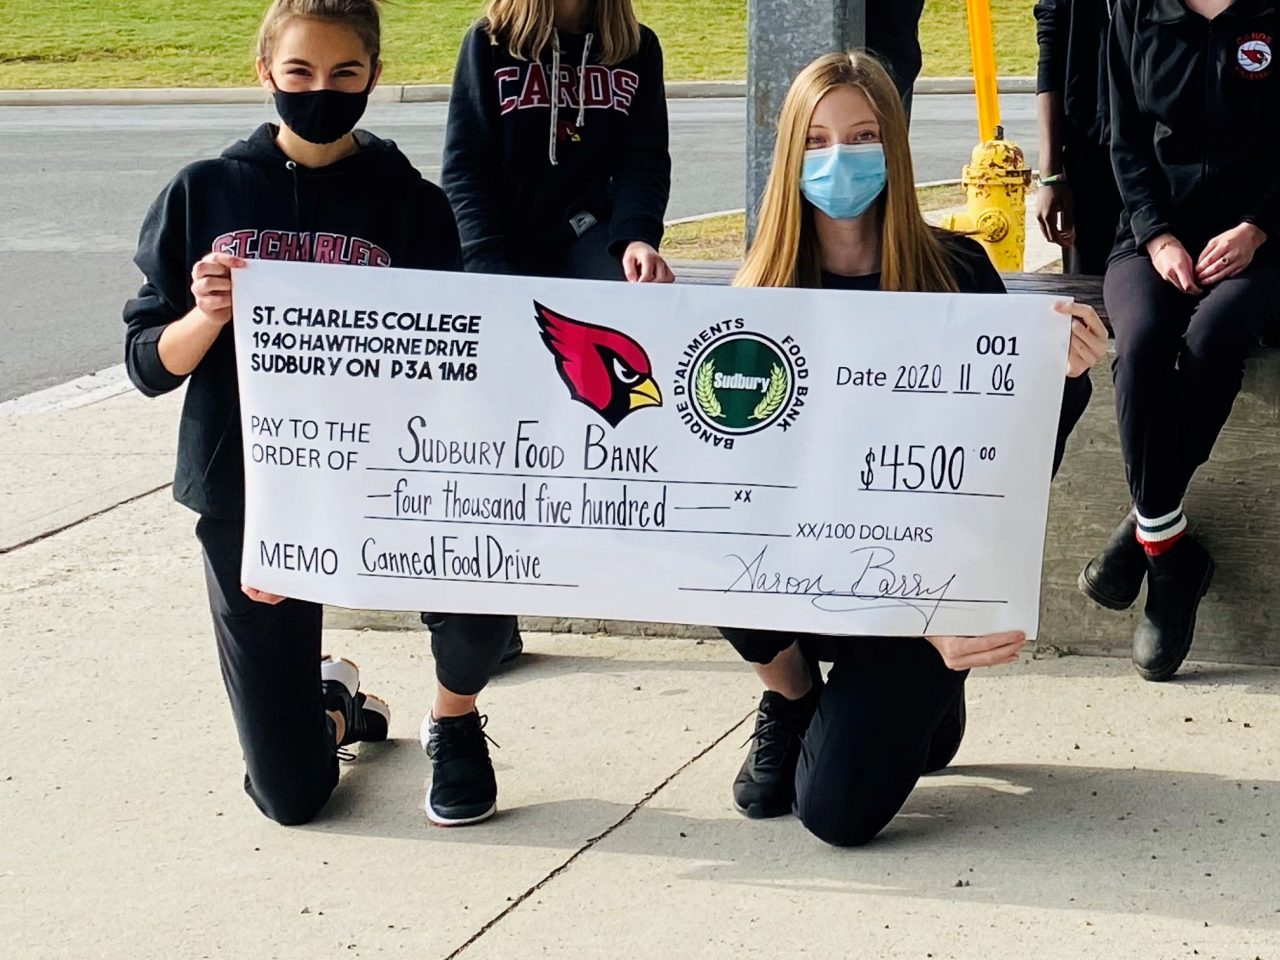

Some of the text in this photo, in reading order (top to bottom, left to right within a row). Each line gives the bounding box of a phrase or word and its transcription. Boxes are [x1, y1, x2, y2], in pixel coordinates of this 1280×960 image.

[494, 63, 639, 115] CARDS
[252, 306, 481, 333] ST. CHARLES COLLEGE
[253, 331, 478, 357] 1940 HAWTHORNE DRIVE
[976, 335, 1020, 356] 001
[251, 353, 478, 381] SUDBURY ON P3A 1M8
[836, 363, 1015, 392] Date 2020 11 06
[674, 318, 745, 450] BANQUE D'ALIMENTS
[713, 372, 770, 393] Sudbury
[777, 335, 809, 432] FOOD BANK
[251, 415, 371, 443] PAY TO THE
[252, 443, 358, 470] ORDER OF
[860, 444, 965, 490] $4500
[394, 478, 432, 516] four
[442, 480, 526, 522] thousand
[535, 482, 572, 524] five
[581, 483, 667, 528] hundred
[796, 523, 933, 542] XX/100 DOLLARS
[260, 540, 338, 575] MEMO
[361, 535, 541, 580] Canned Food Drive
[724, 544, 835, 593] Aaron
